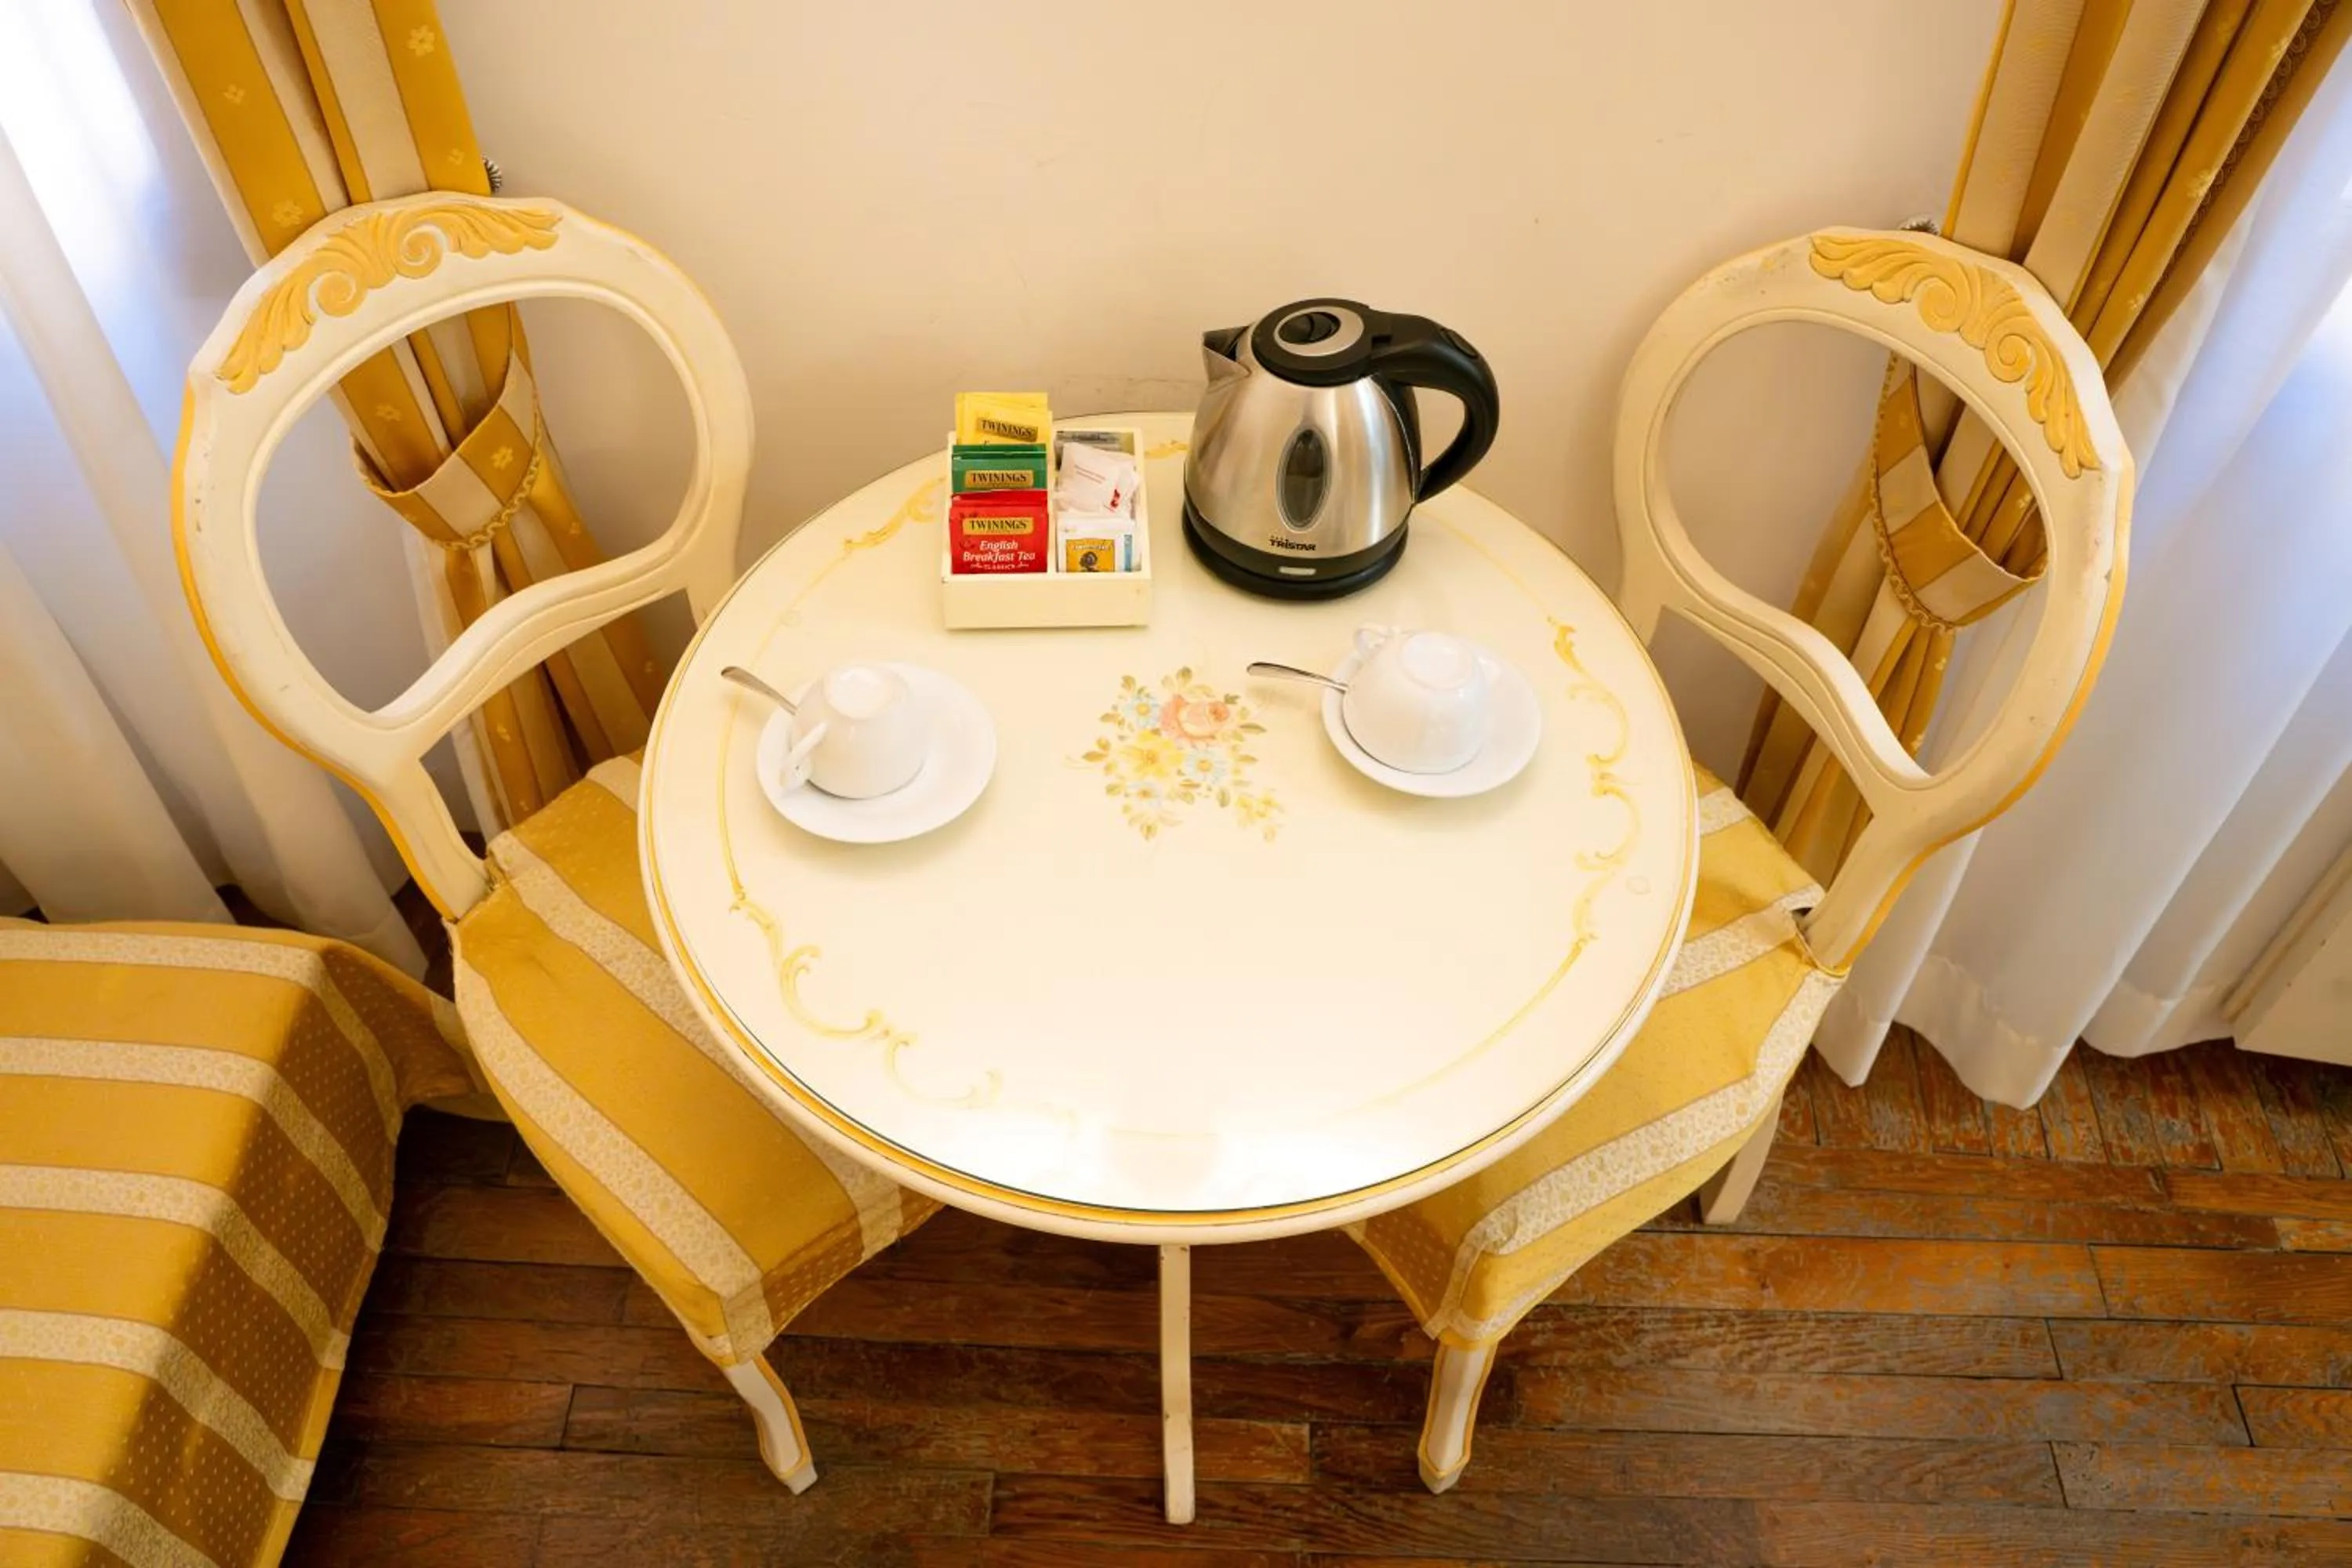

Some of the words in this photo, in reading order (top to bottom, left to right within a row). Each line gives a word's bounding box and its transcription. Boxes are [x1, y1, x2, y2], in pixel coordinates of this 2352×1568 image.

[981, 419, 1032, 437] TWININGS
[972, 473, 1027, 483] TWININGS
[969, 520, 1027, 530] TWININGS
[979, 539, 1018, 553] English
[963, 551, 1014, 564] Breakfast
[1018, 551, 1036, 561] Tea
